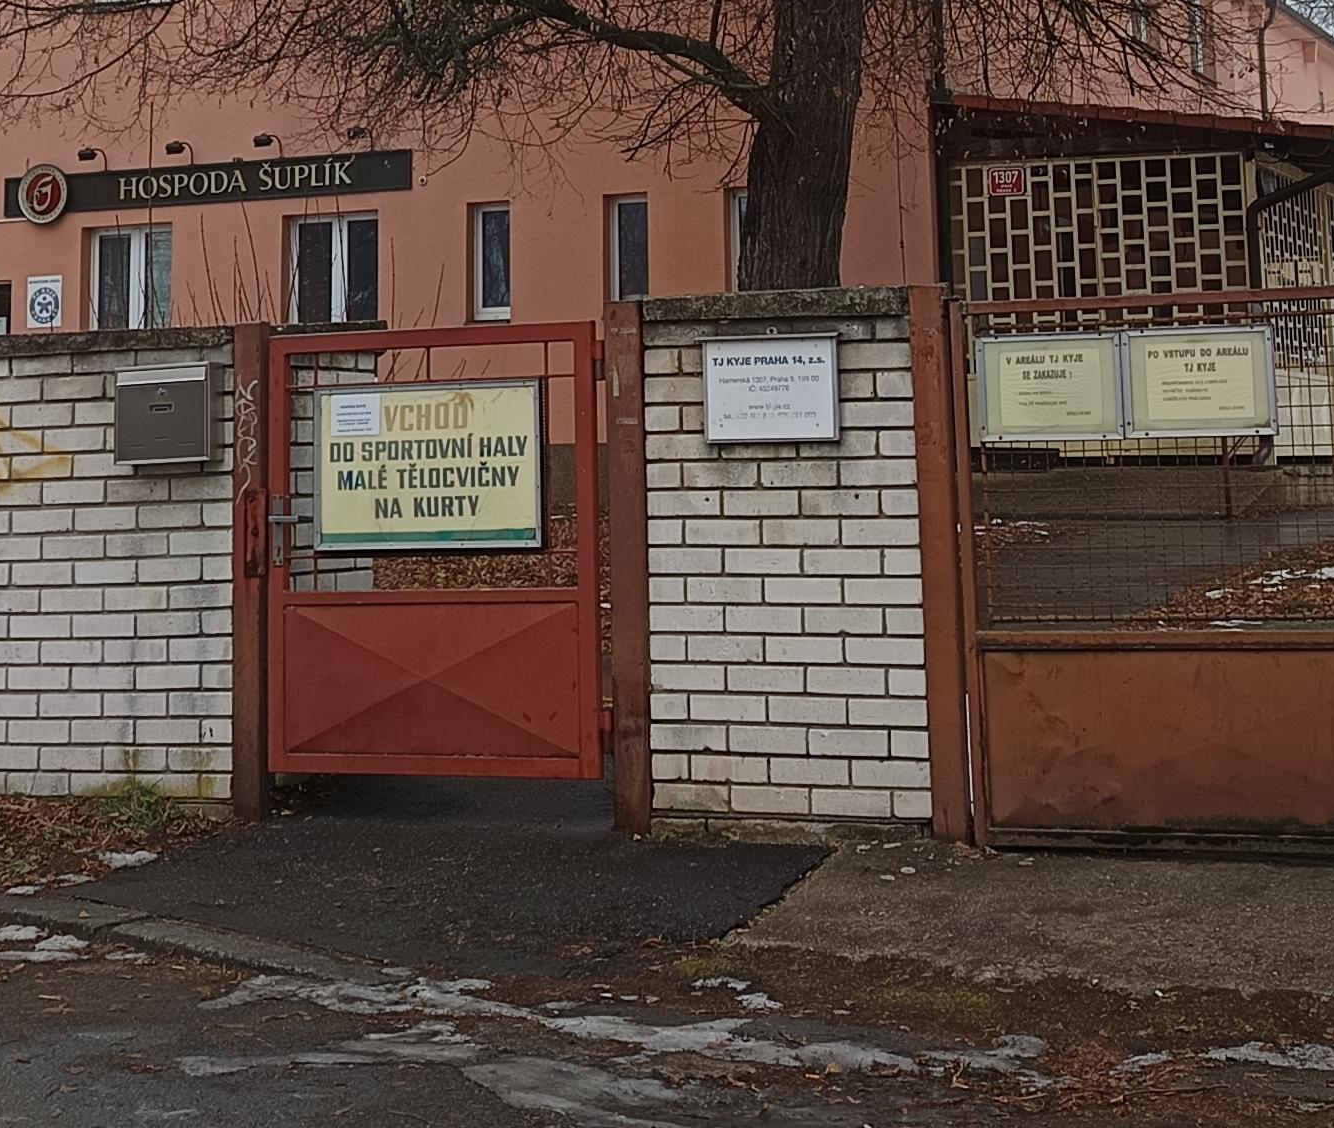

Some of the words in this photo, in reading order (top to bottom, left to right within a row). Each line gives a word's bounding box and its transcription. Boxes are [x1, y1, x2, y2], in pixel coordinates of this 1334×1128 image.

[118, 169, 247, 200] HOSPODA
[259, 155, 355, 191] ŠUPLÍK
[993, 171, 1018, 183] 1307
[712, 358, 724, 366] TJ
[727, 356, 752, 366] KYJE
[754, 356, 789, 365] PRAHA
[792, 355, 806, 366] 14,
[1006, 356, 1012, 365] V
[1015, 354, 1045, 365] AREÁLU
[1049, 354, 1059, 363] TJ
[1063, 353, 1084, 363] KYJE
[1147, 350, 1159, 359] PO
[1163, 349, 1196, 358] VSTUPU
[1200, 348, 1212, 357] DO
[1216, 345, 1249, 357] AREÁLU
[1184, 363, 1193, 373] TJ
[1196, 362, 1216, 372] KYJE
[384, 402, 468, 432] VCHOD
[330, 442, 354, 463] DO
[361, 433, 473, 462] SPORTOVNÍ
[479, 435, 528, 458] HALY
[337, 465, 388, 491] MALÉ
[397, 461, 519, 489] TĚLOCVIČNY
[374, 498, 403, 519] NA
[413, 495, 479, 518] KURTY
